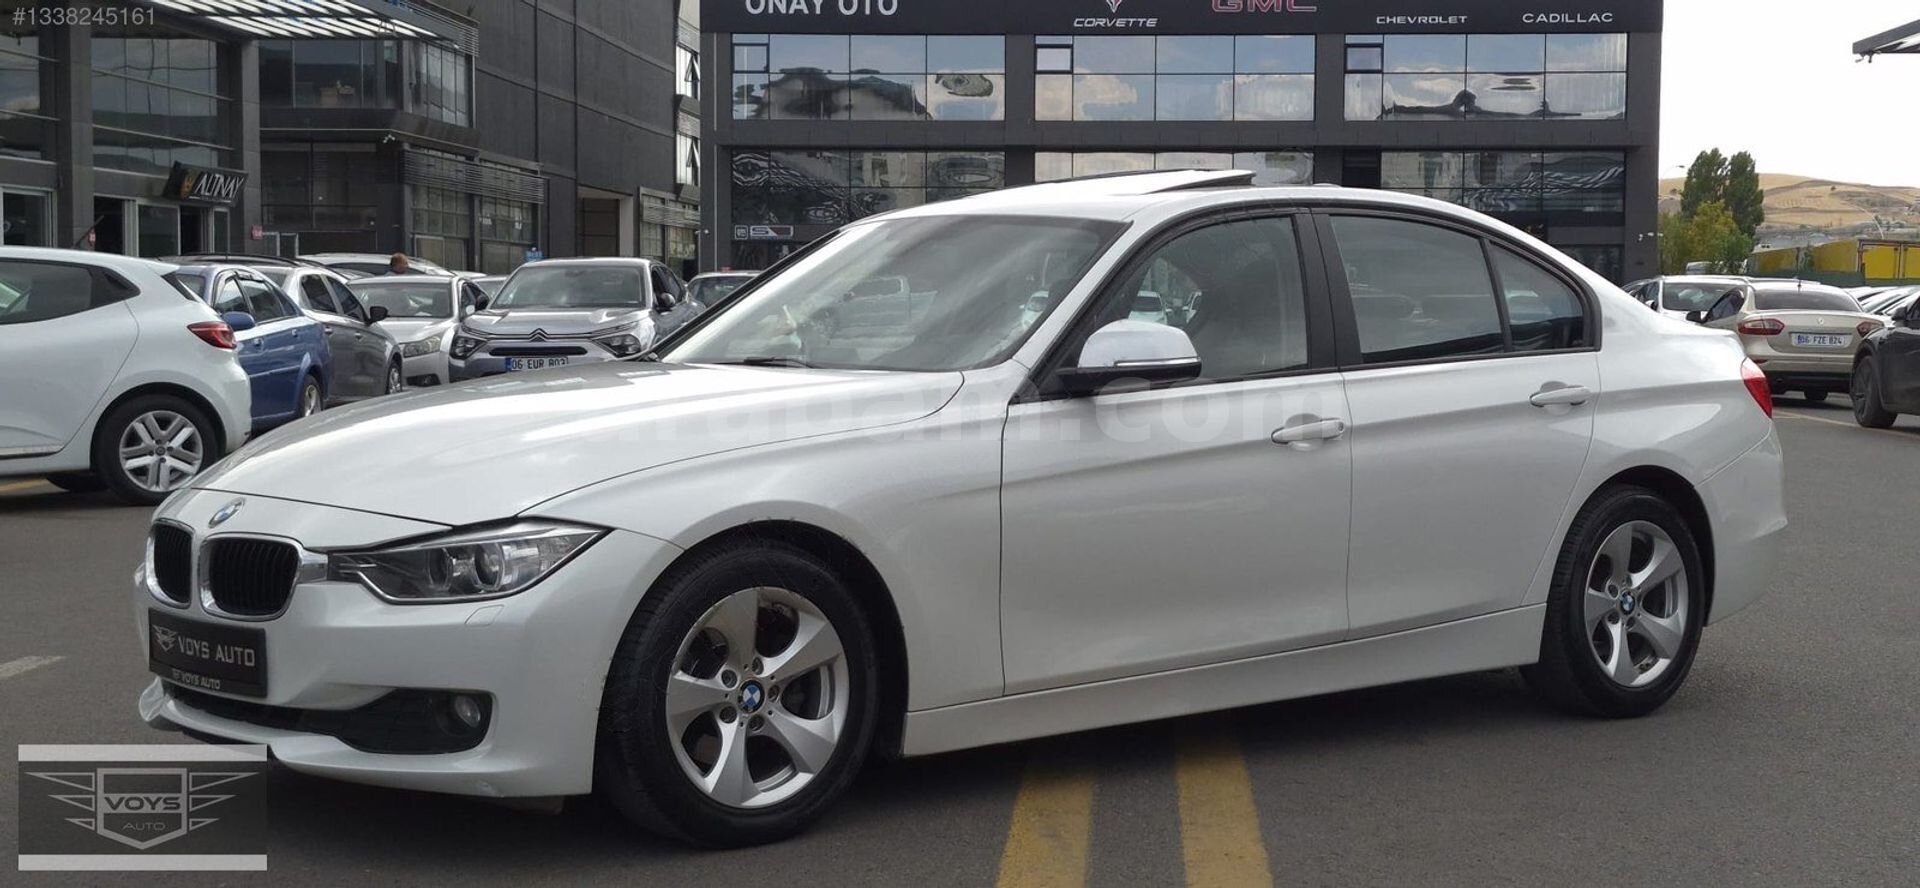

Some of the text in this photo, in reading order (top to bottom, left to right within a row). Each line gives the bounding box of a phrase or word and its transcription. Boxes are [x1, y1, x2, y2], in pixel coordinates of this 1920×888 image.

[745, 0, 822, 15] ONAY
[1073, 18, 1158, 27] CORVETTE
[1376, 15, 1468, 24] CHEVROLET
[1522, 12, 1613, 23] CADILLAC
[512, 360, 522, 369] 06
[528, 359, 544, 369] EUR
[178, 636, 255, 667] VOYS AUTO
[201, 676, 221, 689] AUTO
